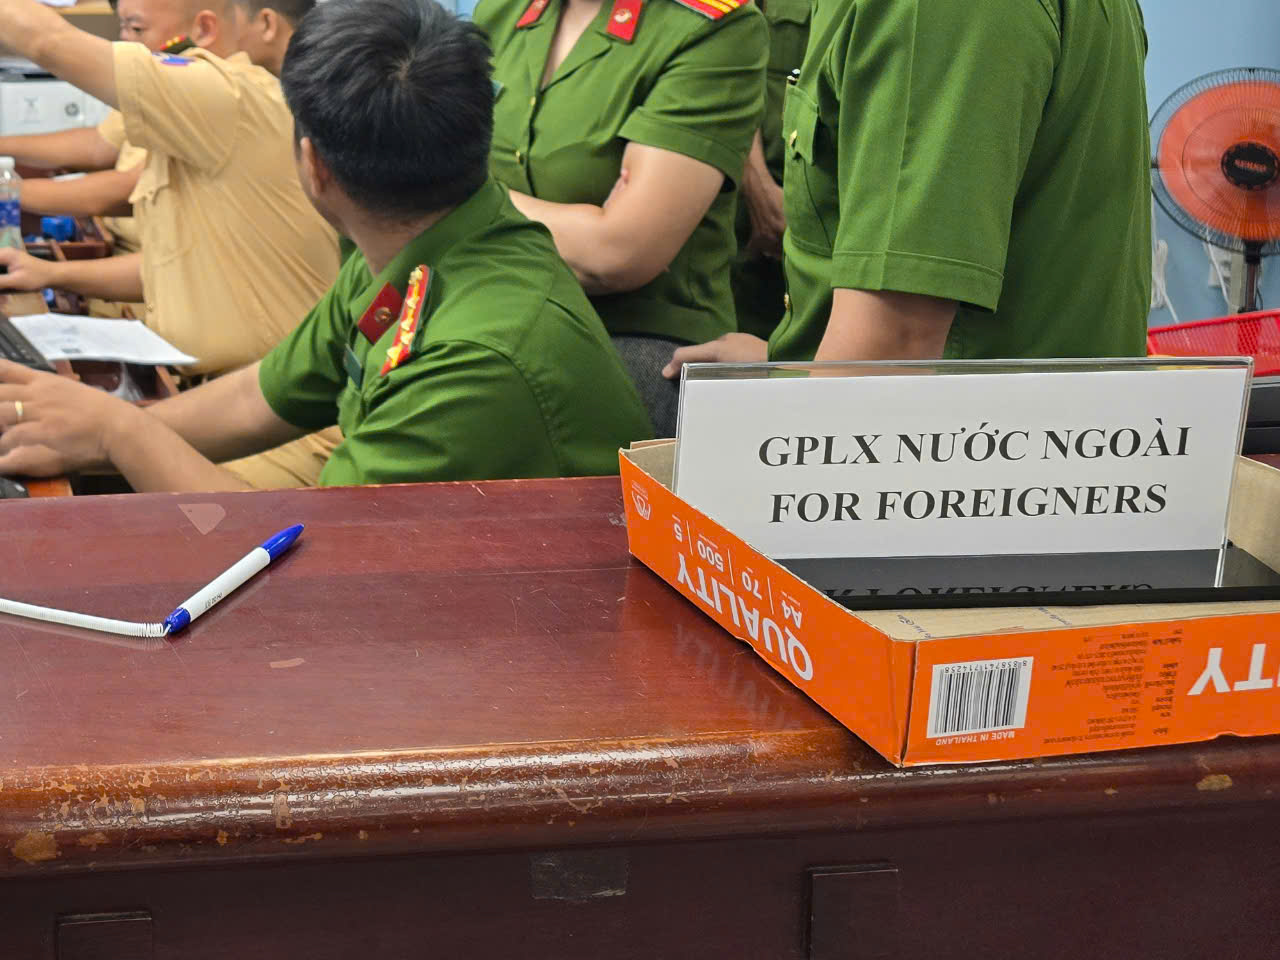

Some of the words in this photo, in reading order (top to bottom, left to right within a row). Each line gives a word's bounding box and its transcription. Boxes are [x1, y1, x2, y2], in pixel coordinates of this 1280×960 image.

[758, 434, 883, 466] GPLX
[893, 422, 1030, 463] NƯỚC
[1040, 418, 1193, 460] NGOÀI
[768, 492, 862, 524] FOR
[874, 484, 1168, 521] FOREIGNERS
[673, 523, 683, 543] 5
[696, 539, 725, 573] 500
[741, 570, 763, 600] 70
[677, 551, 814, 681] QUALITY
[780, 599, 803, 630] A4
[935, 735, 978, 746] THAILAND
[980, 733, 990, 741] IN
[991, 730, 1016, 740] MADE
